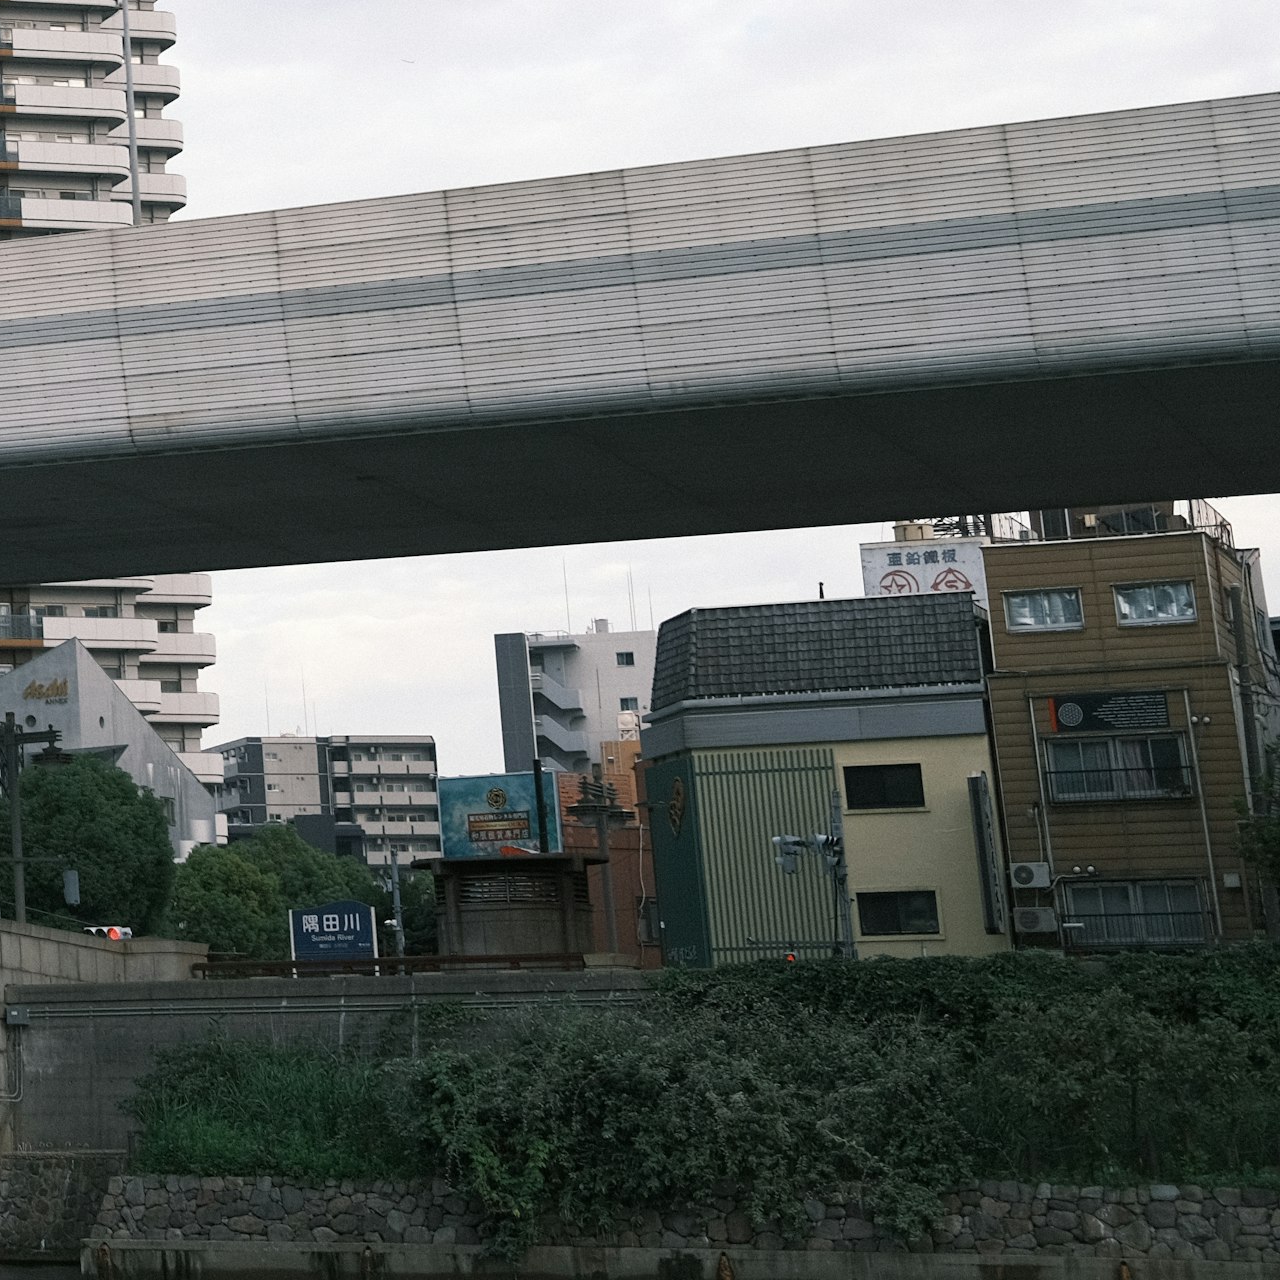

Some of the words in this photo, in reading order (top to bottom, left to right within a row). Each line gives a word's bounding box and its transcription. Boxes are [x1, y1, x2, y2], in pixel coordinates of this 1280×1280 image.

[23, 678, 68, 699] Asahi
[302, 913, 360, 933] 隅田川
